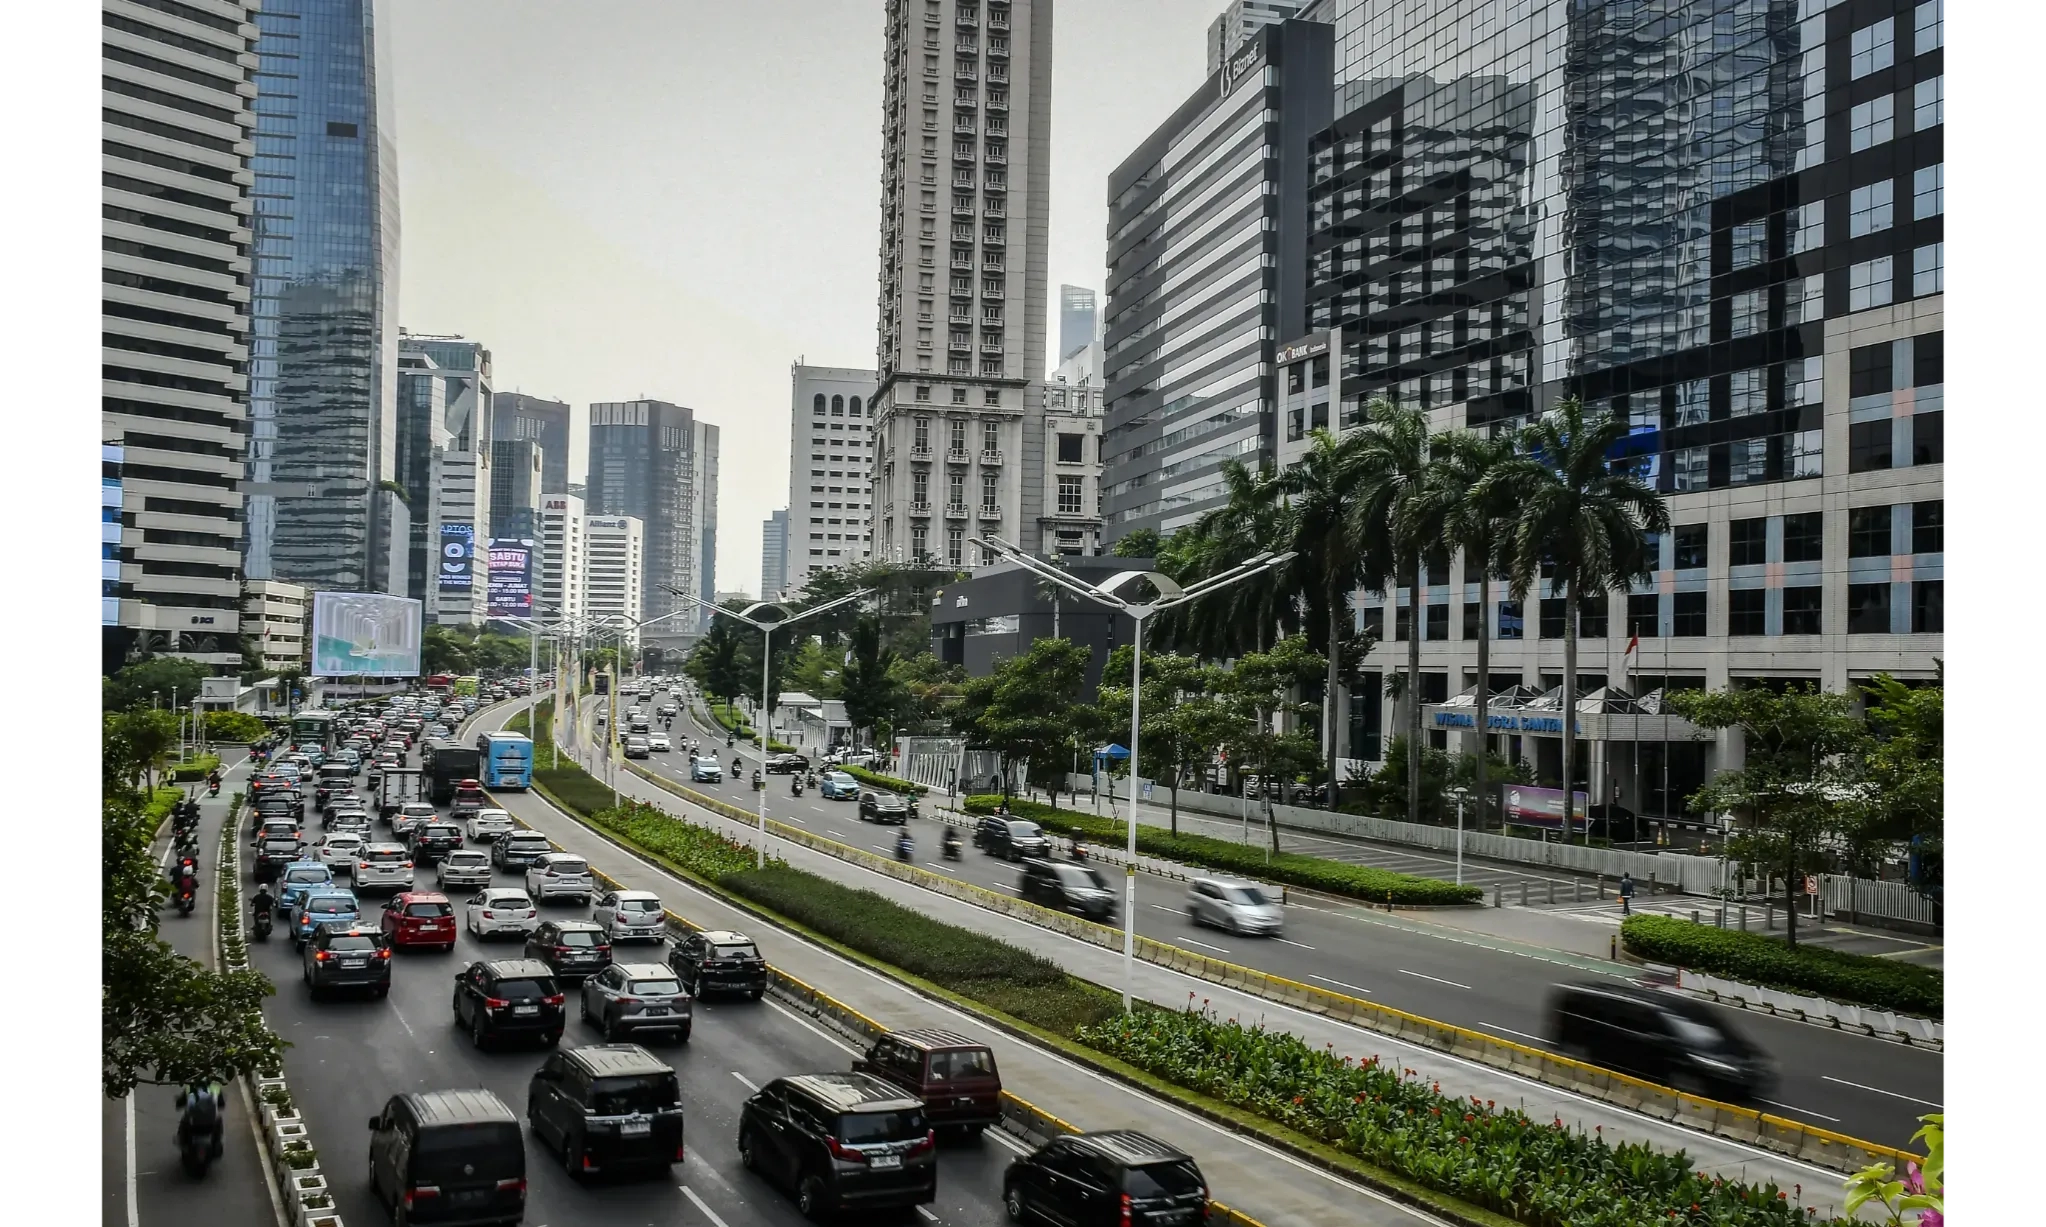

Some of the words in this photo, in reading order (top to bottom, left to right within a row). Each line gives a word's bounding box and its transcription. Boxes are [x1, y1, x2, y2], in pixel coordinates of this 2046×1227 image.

[1232, 41, 1259, 80] Biznet
[1276, 350, 1288, 363] OK
[1291, 344, 1308, 359] BANK
[545, 500, 567, 510] ABB
[589, 519, 616, 528] Allianz
[489, 552, 525, 561] SABTU
[1434, 712, 1475, 727] WISMA
